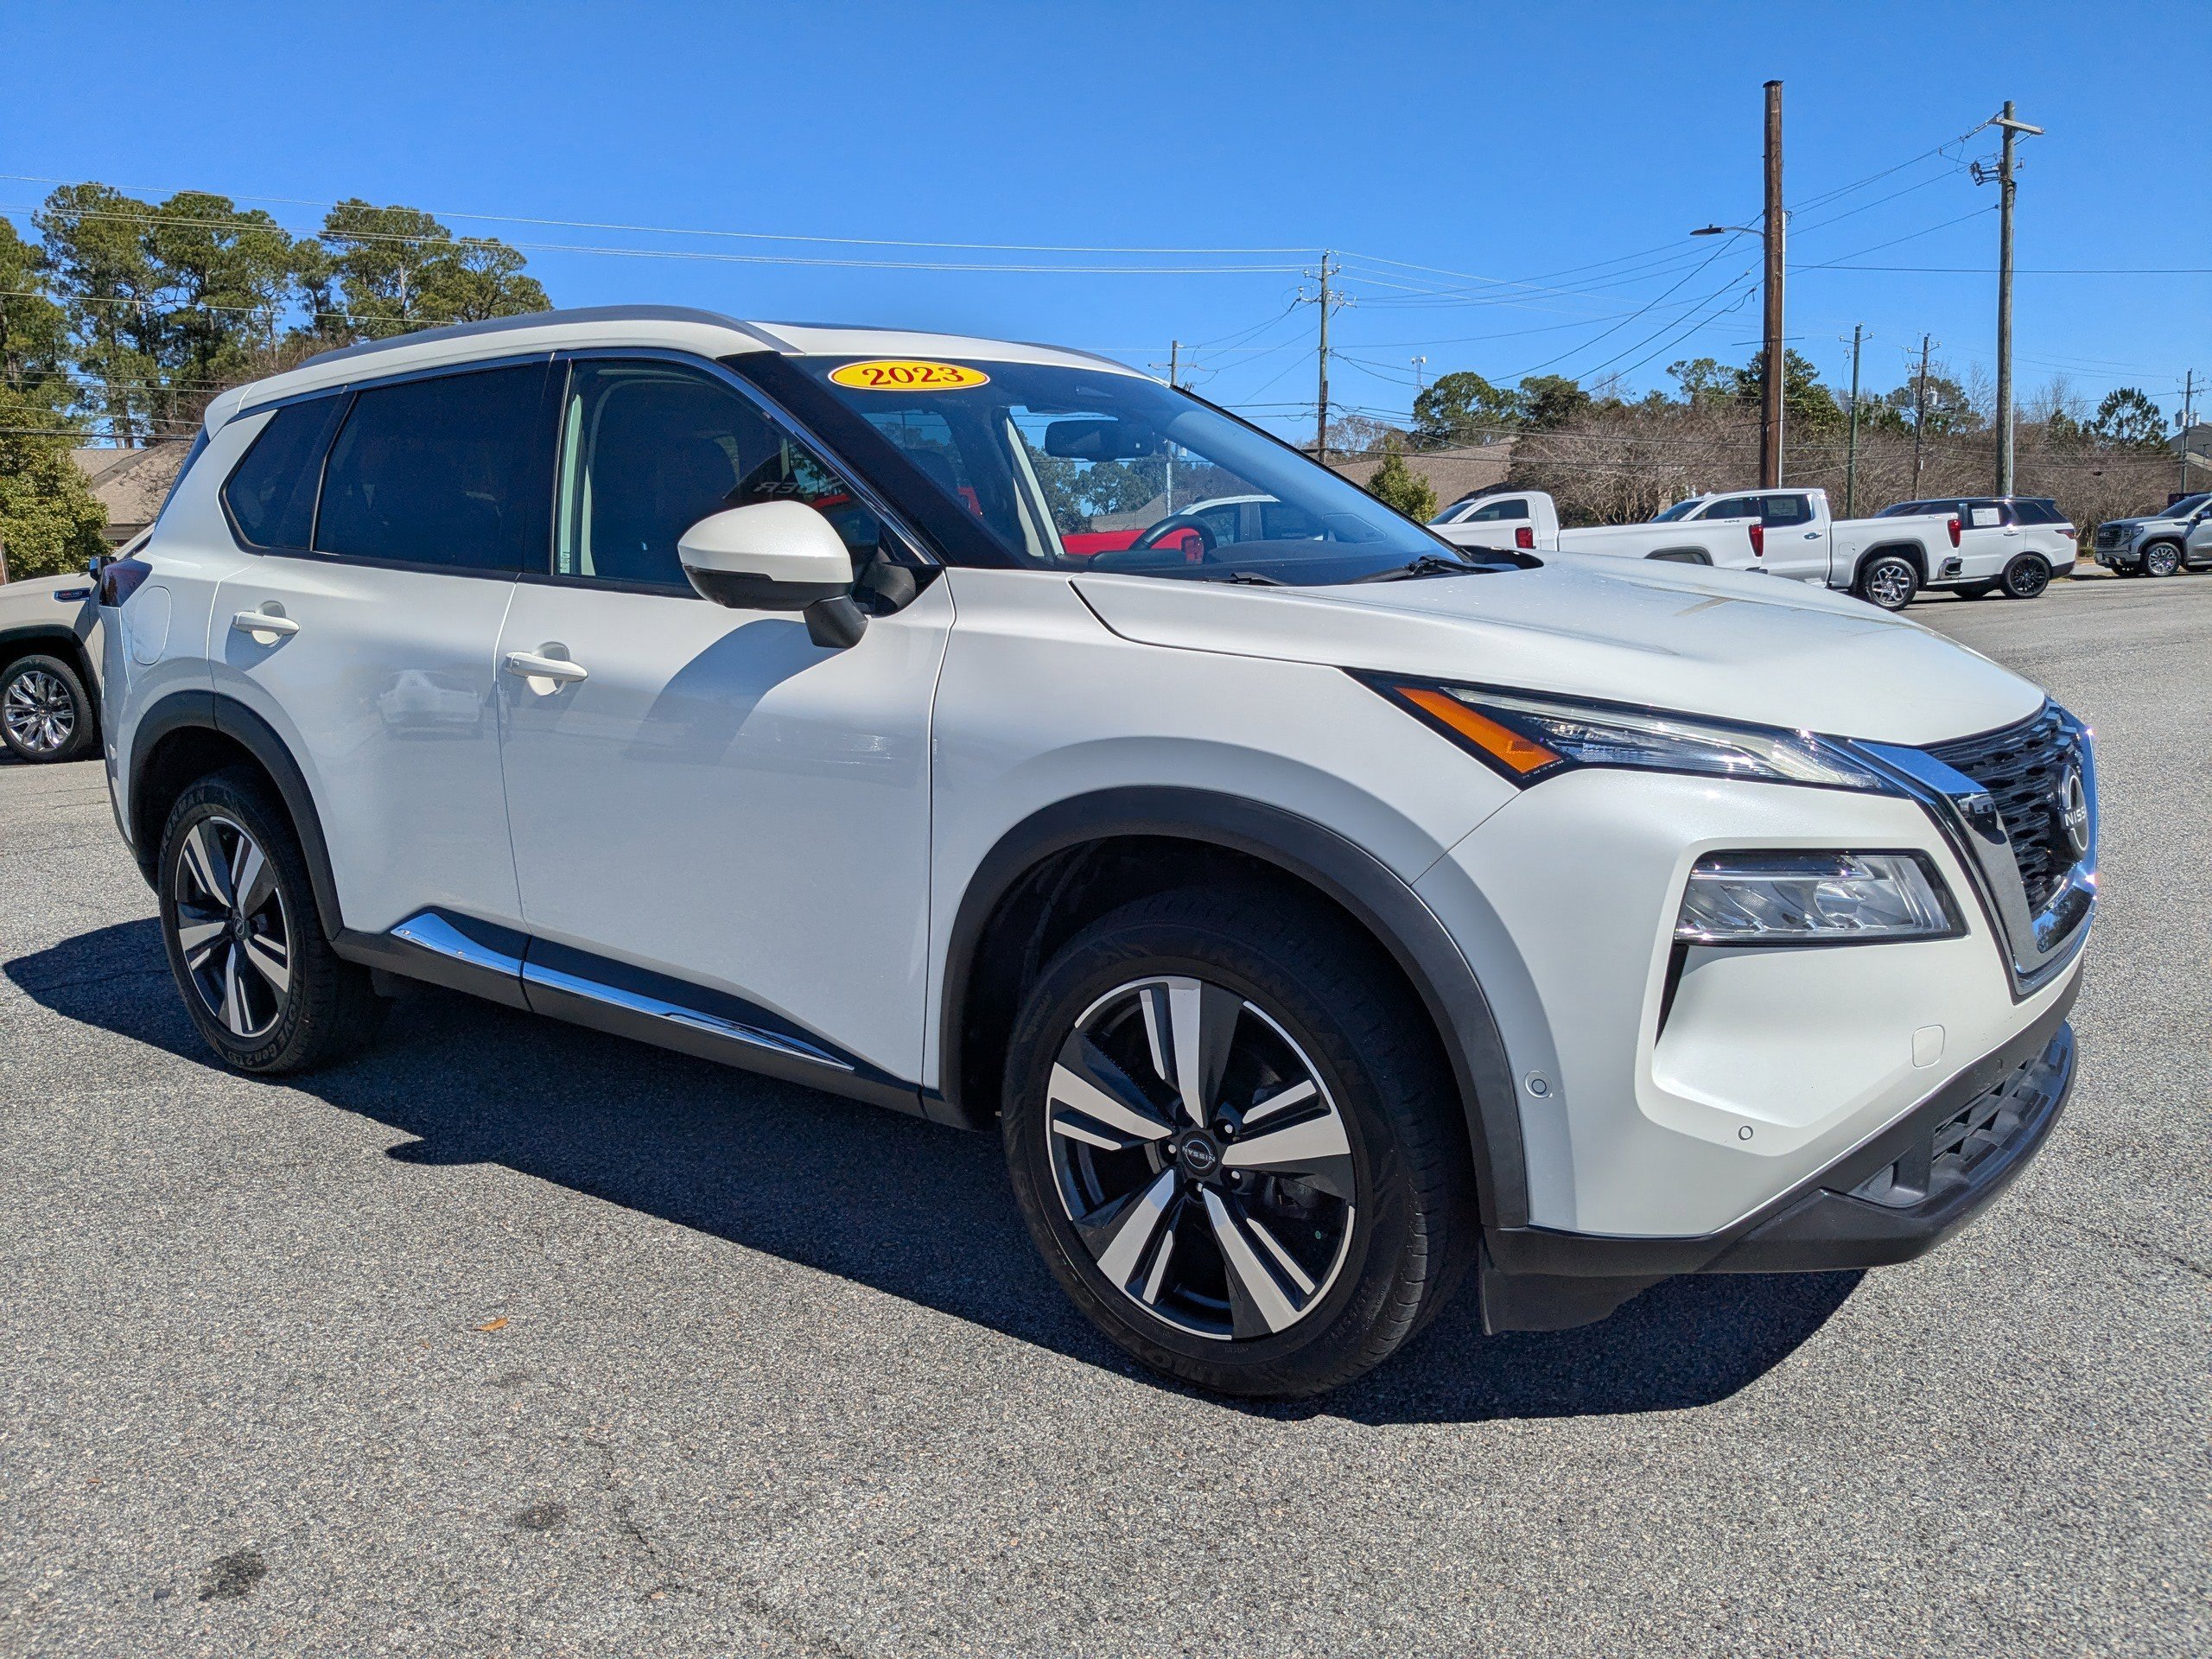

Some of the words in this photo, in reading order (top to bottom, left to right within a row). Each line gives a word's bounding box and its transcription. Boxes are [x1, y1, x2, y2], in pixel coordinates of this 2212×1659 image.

[862, 366, 964, 386] 2023
[2064, 805, 2087, 827] NISS
[1182, 1145, 1216, 1163] NISSAN
